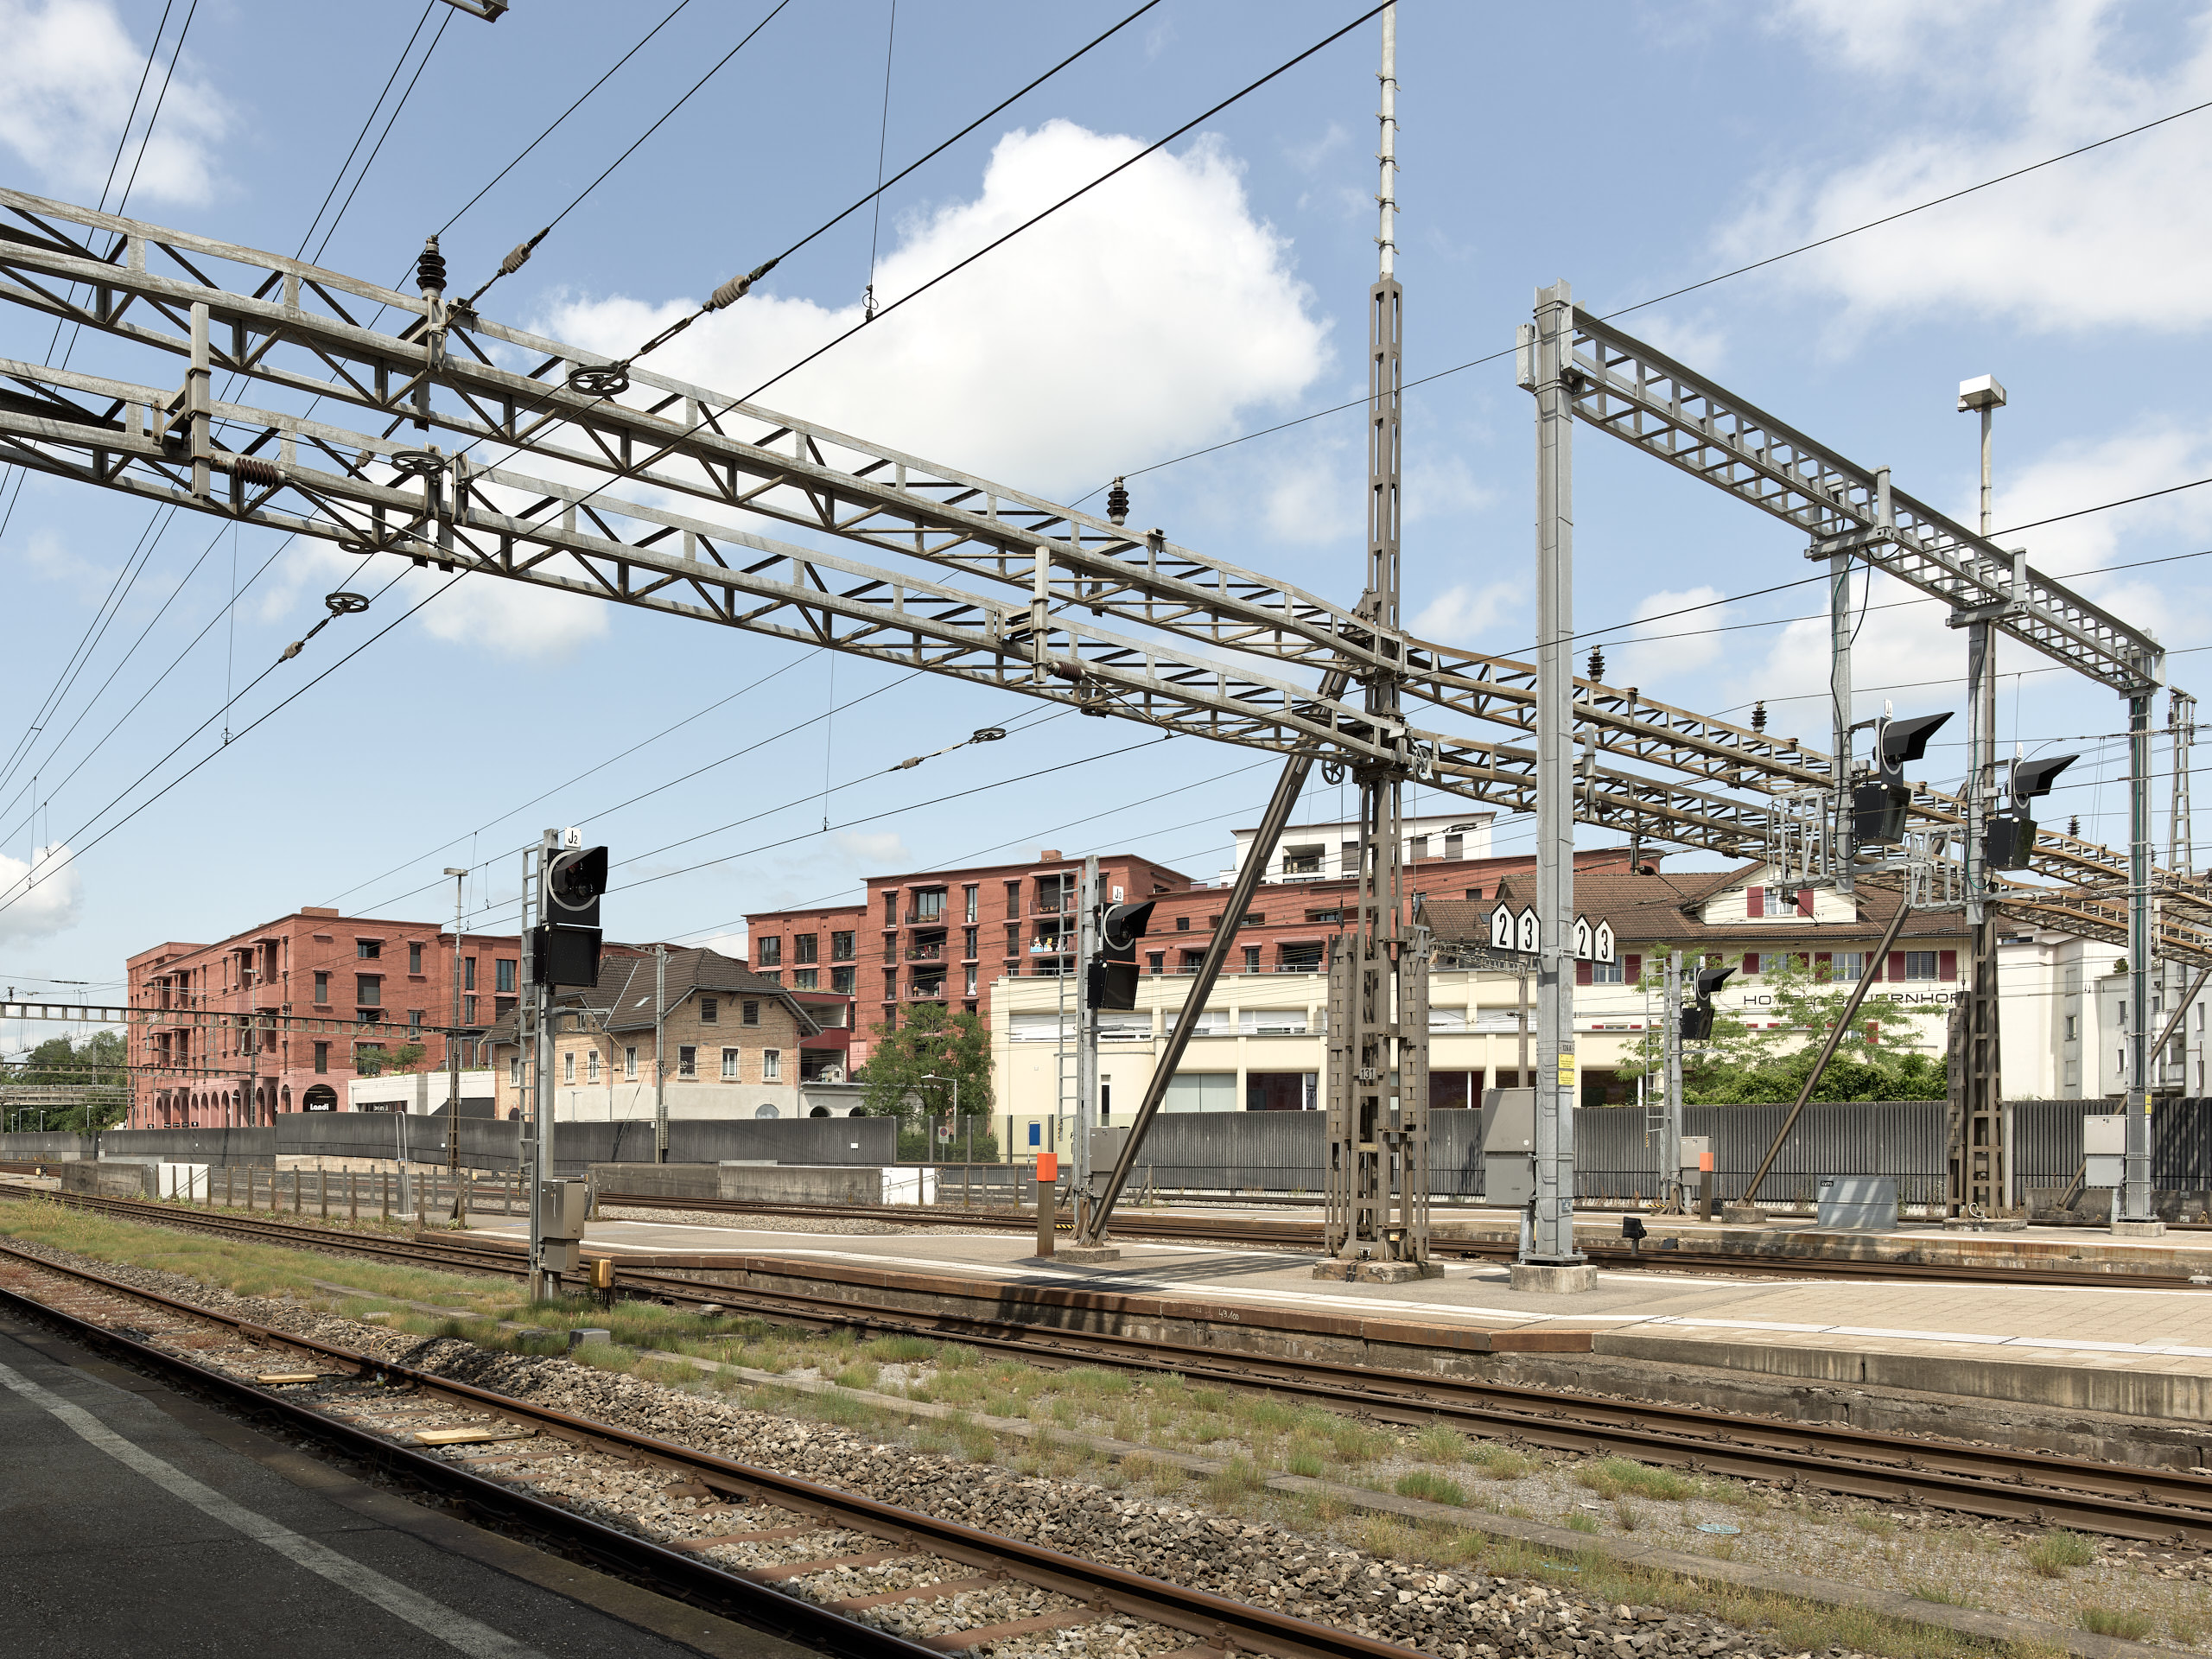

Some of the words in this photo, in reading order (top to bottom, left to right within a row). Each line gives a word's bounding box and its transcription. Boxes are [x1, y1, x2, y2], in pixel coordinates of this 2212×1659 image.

[568, 830, 578, 844] J2
[1115, 887, 1122, 899] J3
[1498, 912, 1507, 946] 2
[1524, 917, 1533, 950] 3
[1579, 925, 1586, 957] 2
[1601, 929, 1608, 960] 3
[1361, 1068, 1374, 1079] 131
[309, 1103, 329, 1111] Landi
